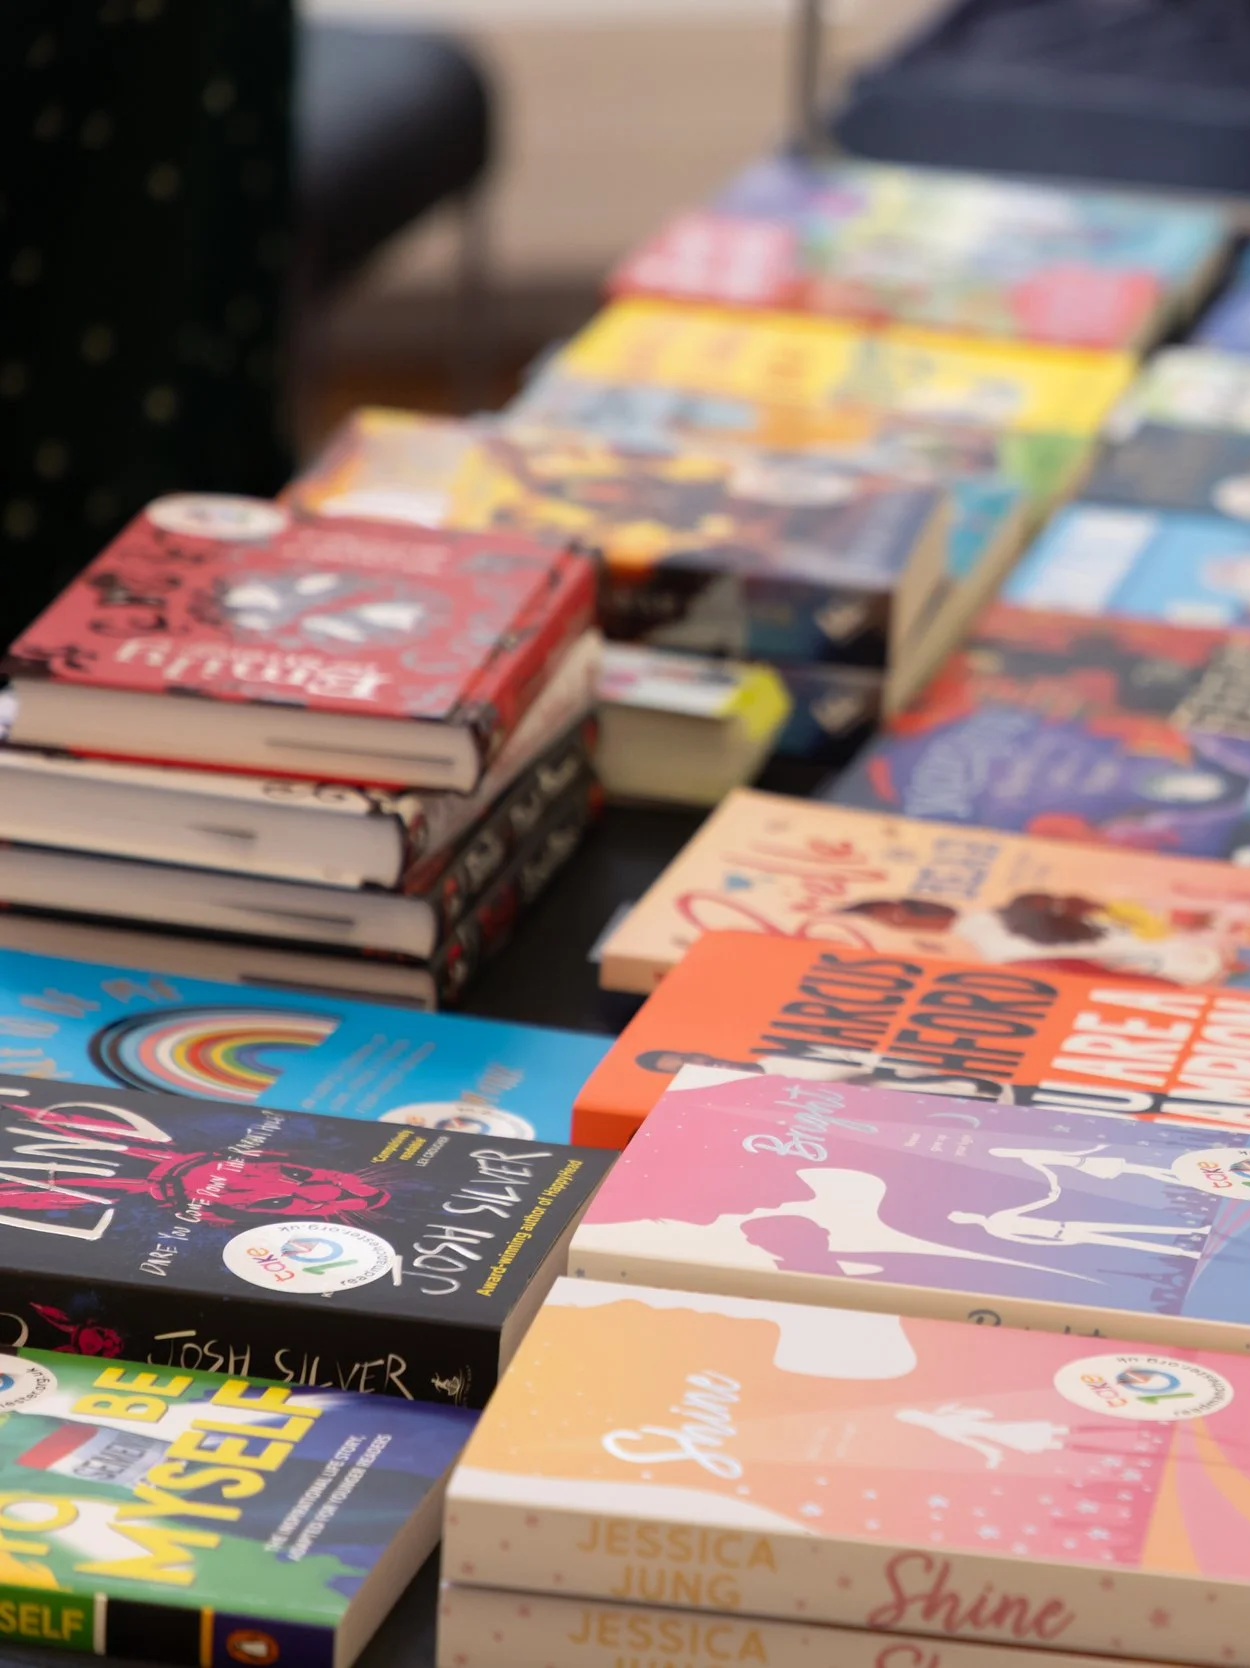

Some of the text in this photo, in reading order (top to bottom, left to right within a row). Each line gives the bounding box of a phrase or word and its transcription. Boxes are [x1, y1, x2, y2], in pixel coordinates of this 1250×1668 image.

[749, 953, 924, 1068] MARCUS
[1089, 988, 1208, 1019] A
[872, 971, 1060, 1101] SHFORD
[1052, 1012, 1194, 1086] ARE
[742, 1085, 879, 1162] Bright
[196, 1174, 228, 1199] DOWN
[217, 1156, 245, 1173] THE
[442, 1149, 553, 1219] SILVER
[1197, 1161, 1233, 1189] take
[157, 1226, 191, 1241] YOU
[175, 1198, 211, 1224] COME
[476, 1158, 584, 1297] Award-winning author of HappyHead
[139, 1243, 178, 1277] DARE
[246, 1247, 295, 1284] take
[391, 1223, 495, 1296] JOSH
[147, 1329, 414, 1400] JOSH SILVER
[70, 1366, 194, 1424] BE
[356, 1433, 393, 1468] READERS
[601, 1369, 742, 1480] Shine
[73, 1378, 325, 1588] MYSELF
[576, 1517, 780, 1575] JESSICA
[610, 1564, 742, 1611] JUNG
[866, 1550, 1077, 1640] Shine
[567, 1607, 769, 1665] JESSICA
